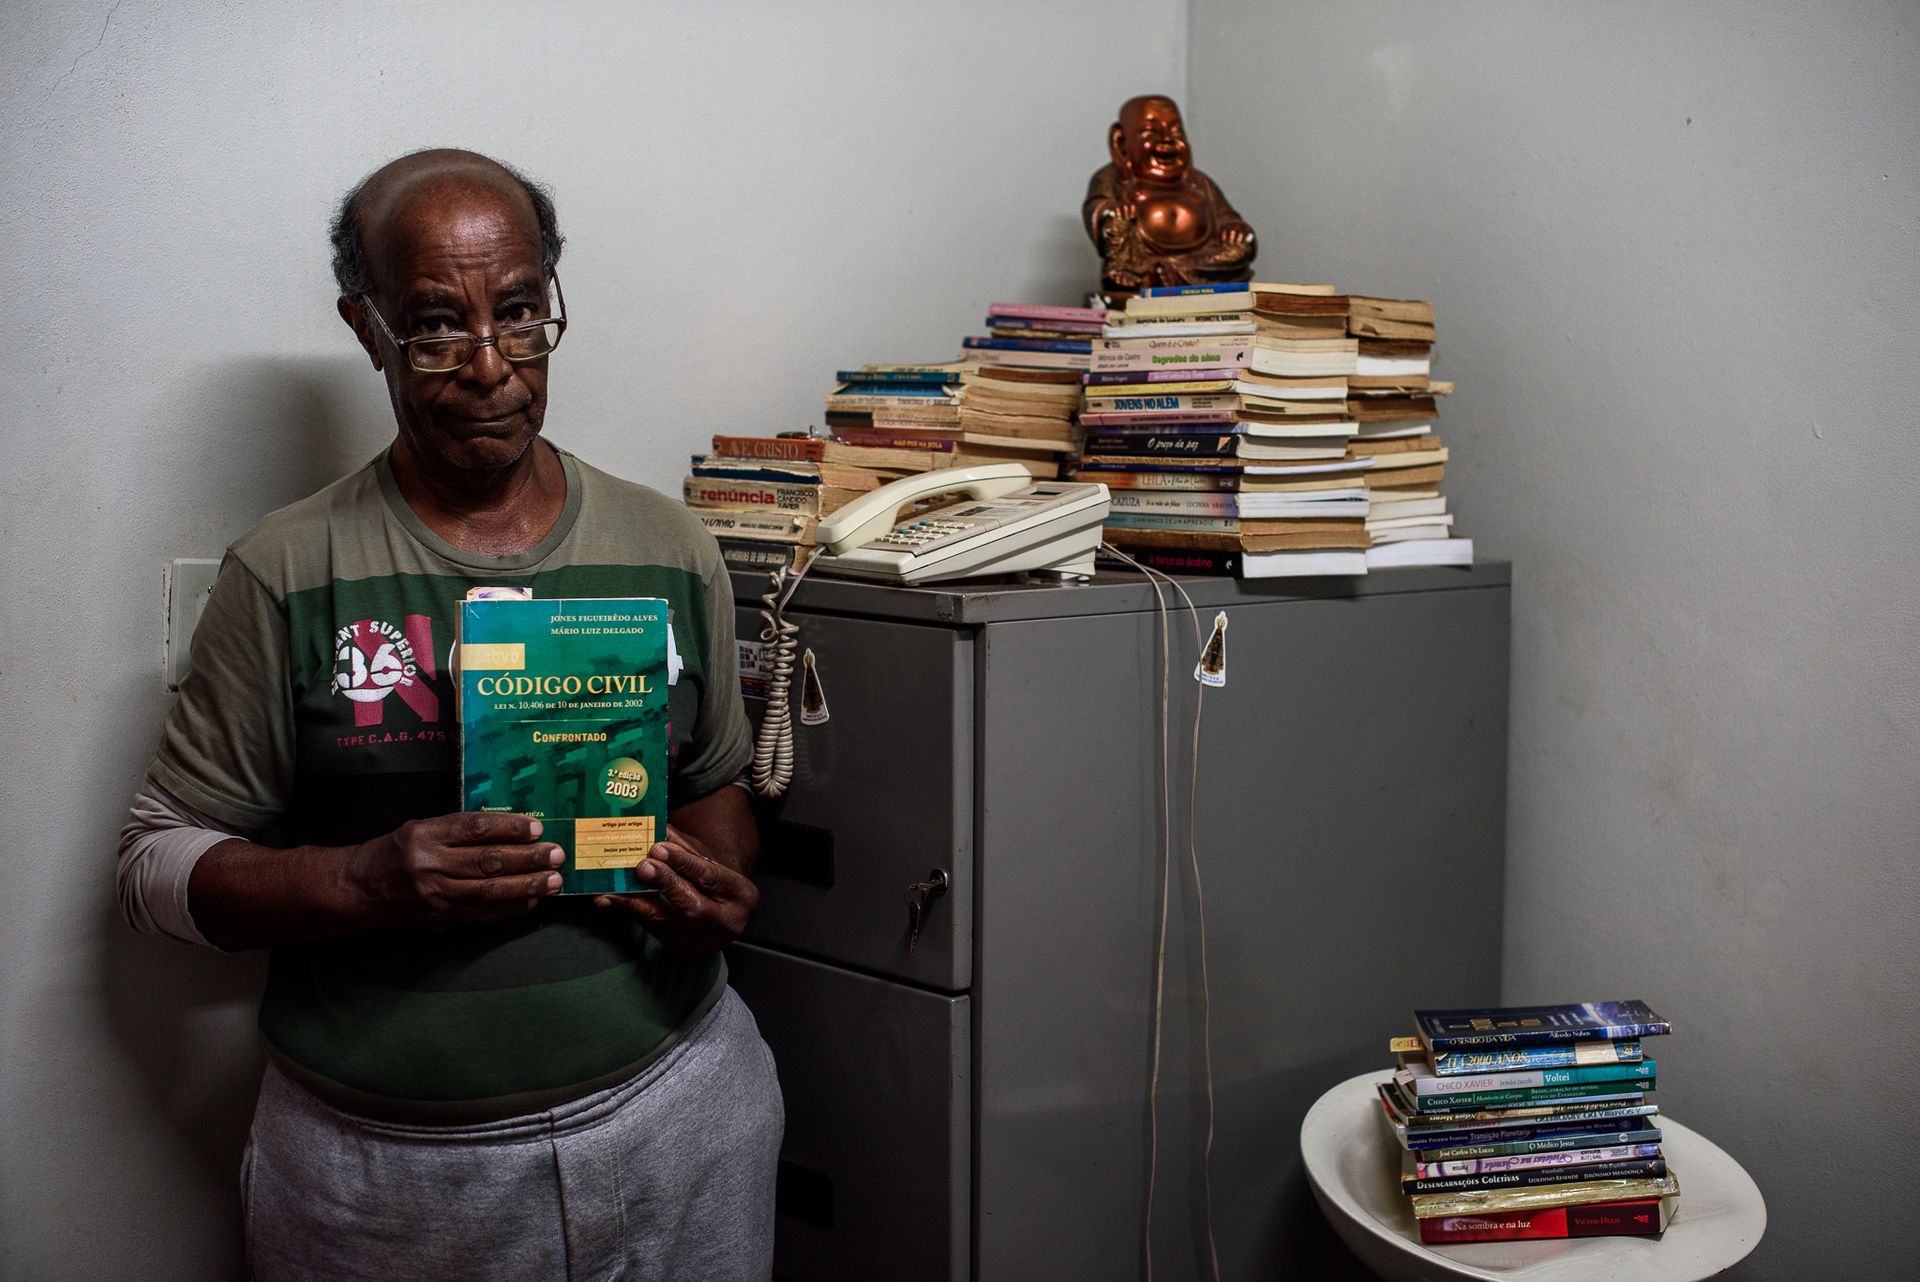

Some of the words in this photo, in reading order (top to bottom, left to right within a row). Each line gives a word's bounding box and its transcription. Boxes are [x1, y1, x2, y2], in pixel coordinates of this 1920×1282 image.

[1114, 398, 1142, 410] JOVENS
[1144, 398, 1156, 409] NO
[1156, 396, 1179, 409] ALÉM
[1148, 438, 1154, 447] O
[754, 442, 799, 460] CRISTO
[700, 486, 775, 505] renúncia
[777, 488, 814, 497] FRANCISCO
[777, 502, 800, 510] XAVIER
[1112, 497, 1140, 508] CAZUZA
[550, 615, 576, 623] JONES
[578, 613, 630, 622] FIGUEIRÊDO
[551, 626, 580, 635] MÁRIO
[369, 620, 417, 687] SUPERIOR
[336, 643, 403, 688] 36
[477, 672, 582, 696] CÓDIGO
[587, 675, 653, 694] CIVIL
[519, 701, 544, 710] 10.406
[580, 701, 611, 709] JANEIRO
[625, 699, 643, 707] 2002
[336, 735, 365, 748] TYPE
[618, 771, 641, 781] edição
[605, 781, 638, 798] 2003
[1466, 1055, 1493, 1066] 2000
[1545, 1072, 1570, 1083] Voltei
[1437, 1081, 1462, 1091] CHICO
[1463, 1079, 1493, 1089] XAVIER
[1598, 1109, 1633, 1118] SOMBRA
[1470, 1131, 1499, 1140] Transição
[1537, 1141, 1559, 1149] Médico
[1560, 1140, 1575, 1148] Jesus
[1439, 1150, 1450, 1158] José
[1612, 1169, 1644, 1177] MENDONÇA
[1468, 1221, 1497, 1230] sombra
[1518, 1220, 1531, 1228] luz
